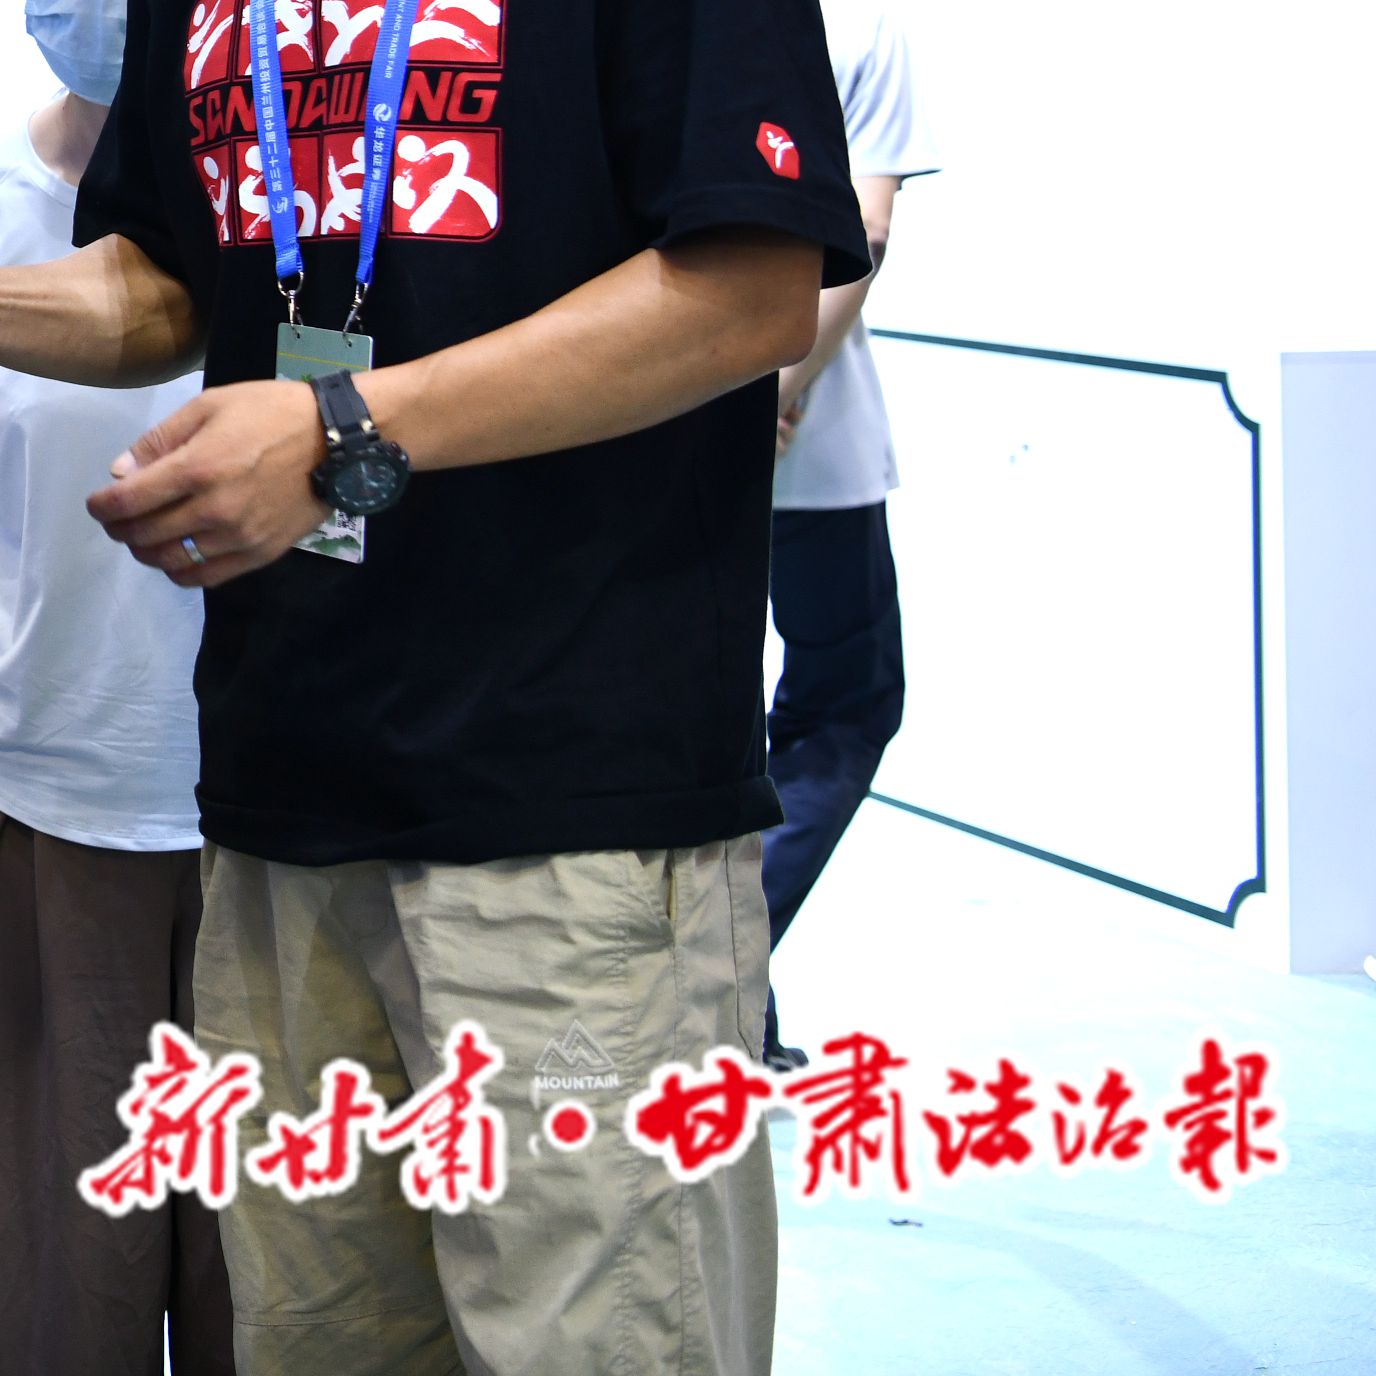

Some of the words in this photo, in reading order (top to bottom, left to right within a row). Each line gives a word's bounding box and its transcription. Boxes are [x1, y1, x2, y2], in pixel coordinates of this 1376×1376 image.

[393, 13, 403, 32] AND
[388, 32, 399, 59] TRADE
[384, 60, 394, 79] FAIR
[254, 0, 282, 192] 第三十二届中国兰州投资贸易洽谈会
[189, 71, 503, 146] SANDAWNG
[534, 1074, 620, 1090] MOUNTAIN
